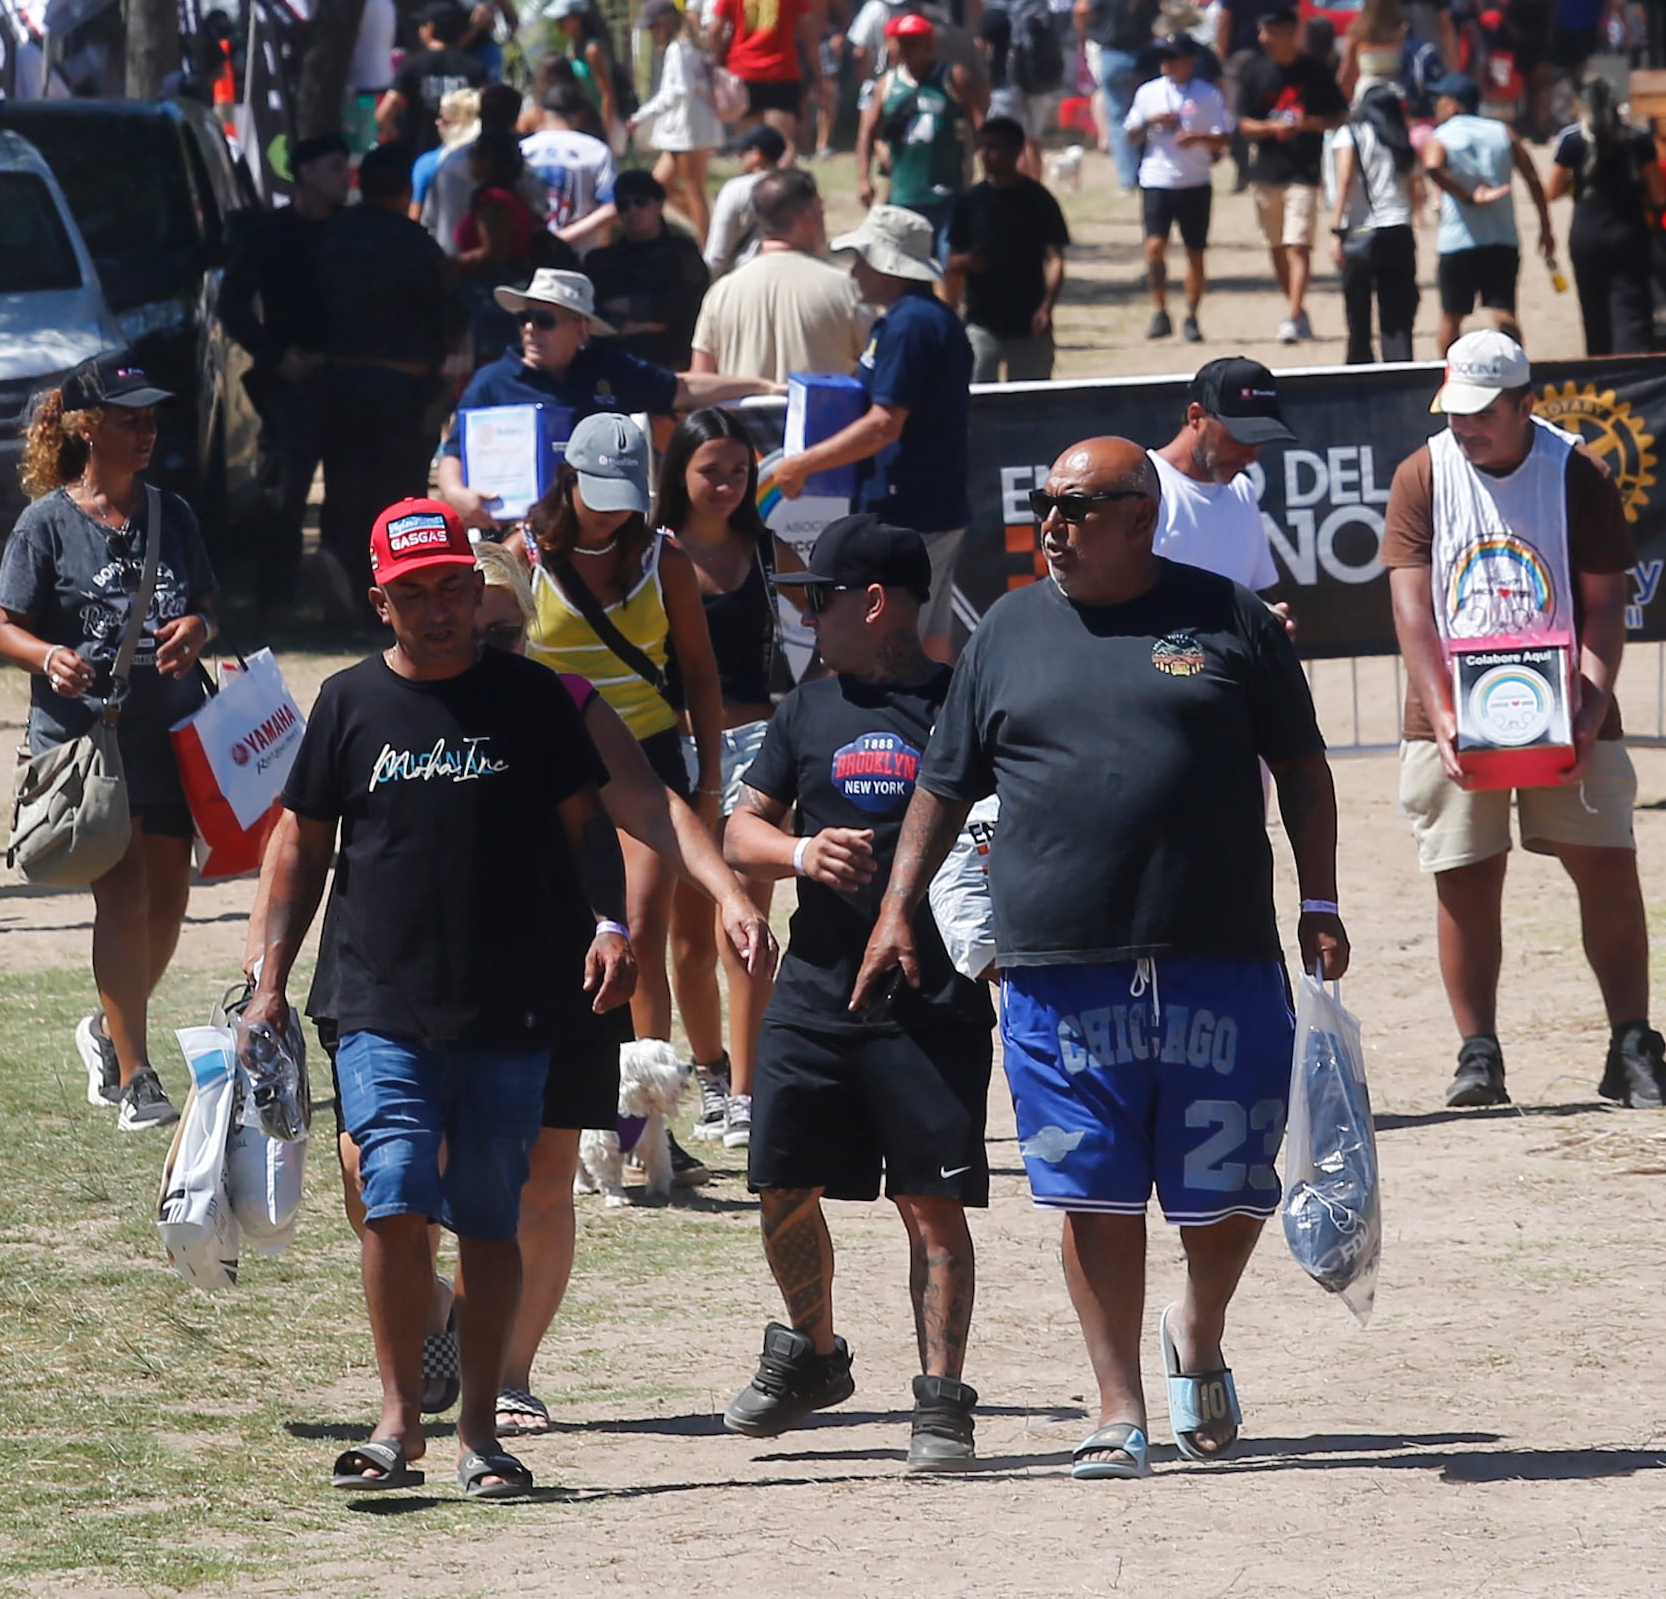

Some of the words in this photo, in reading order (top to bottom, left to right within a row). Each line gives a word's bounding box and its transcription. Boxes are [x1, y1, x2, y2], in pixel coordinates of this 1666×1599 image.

[1282, 445, 1391, 508] DEL
[390, 530, 448, 551] GASGAS
[1465, 651, 1522, 667] Colabore
[242, 703, 297, 754] YAMAHA
[835, 750, 918, 780] BROOKLYN
[844, 780, 873, 795] NEW
[873, 781, 905, 795] YORK
[1057, 1002, 1239, 1076] CHICAGO
[1184, 1099, 1284, 1193] 23
